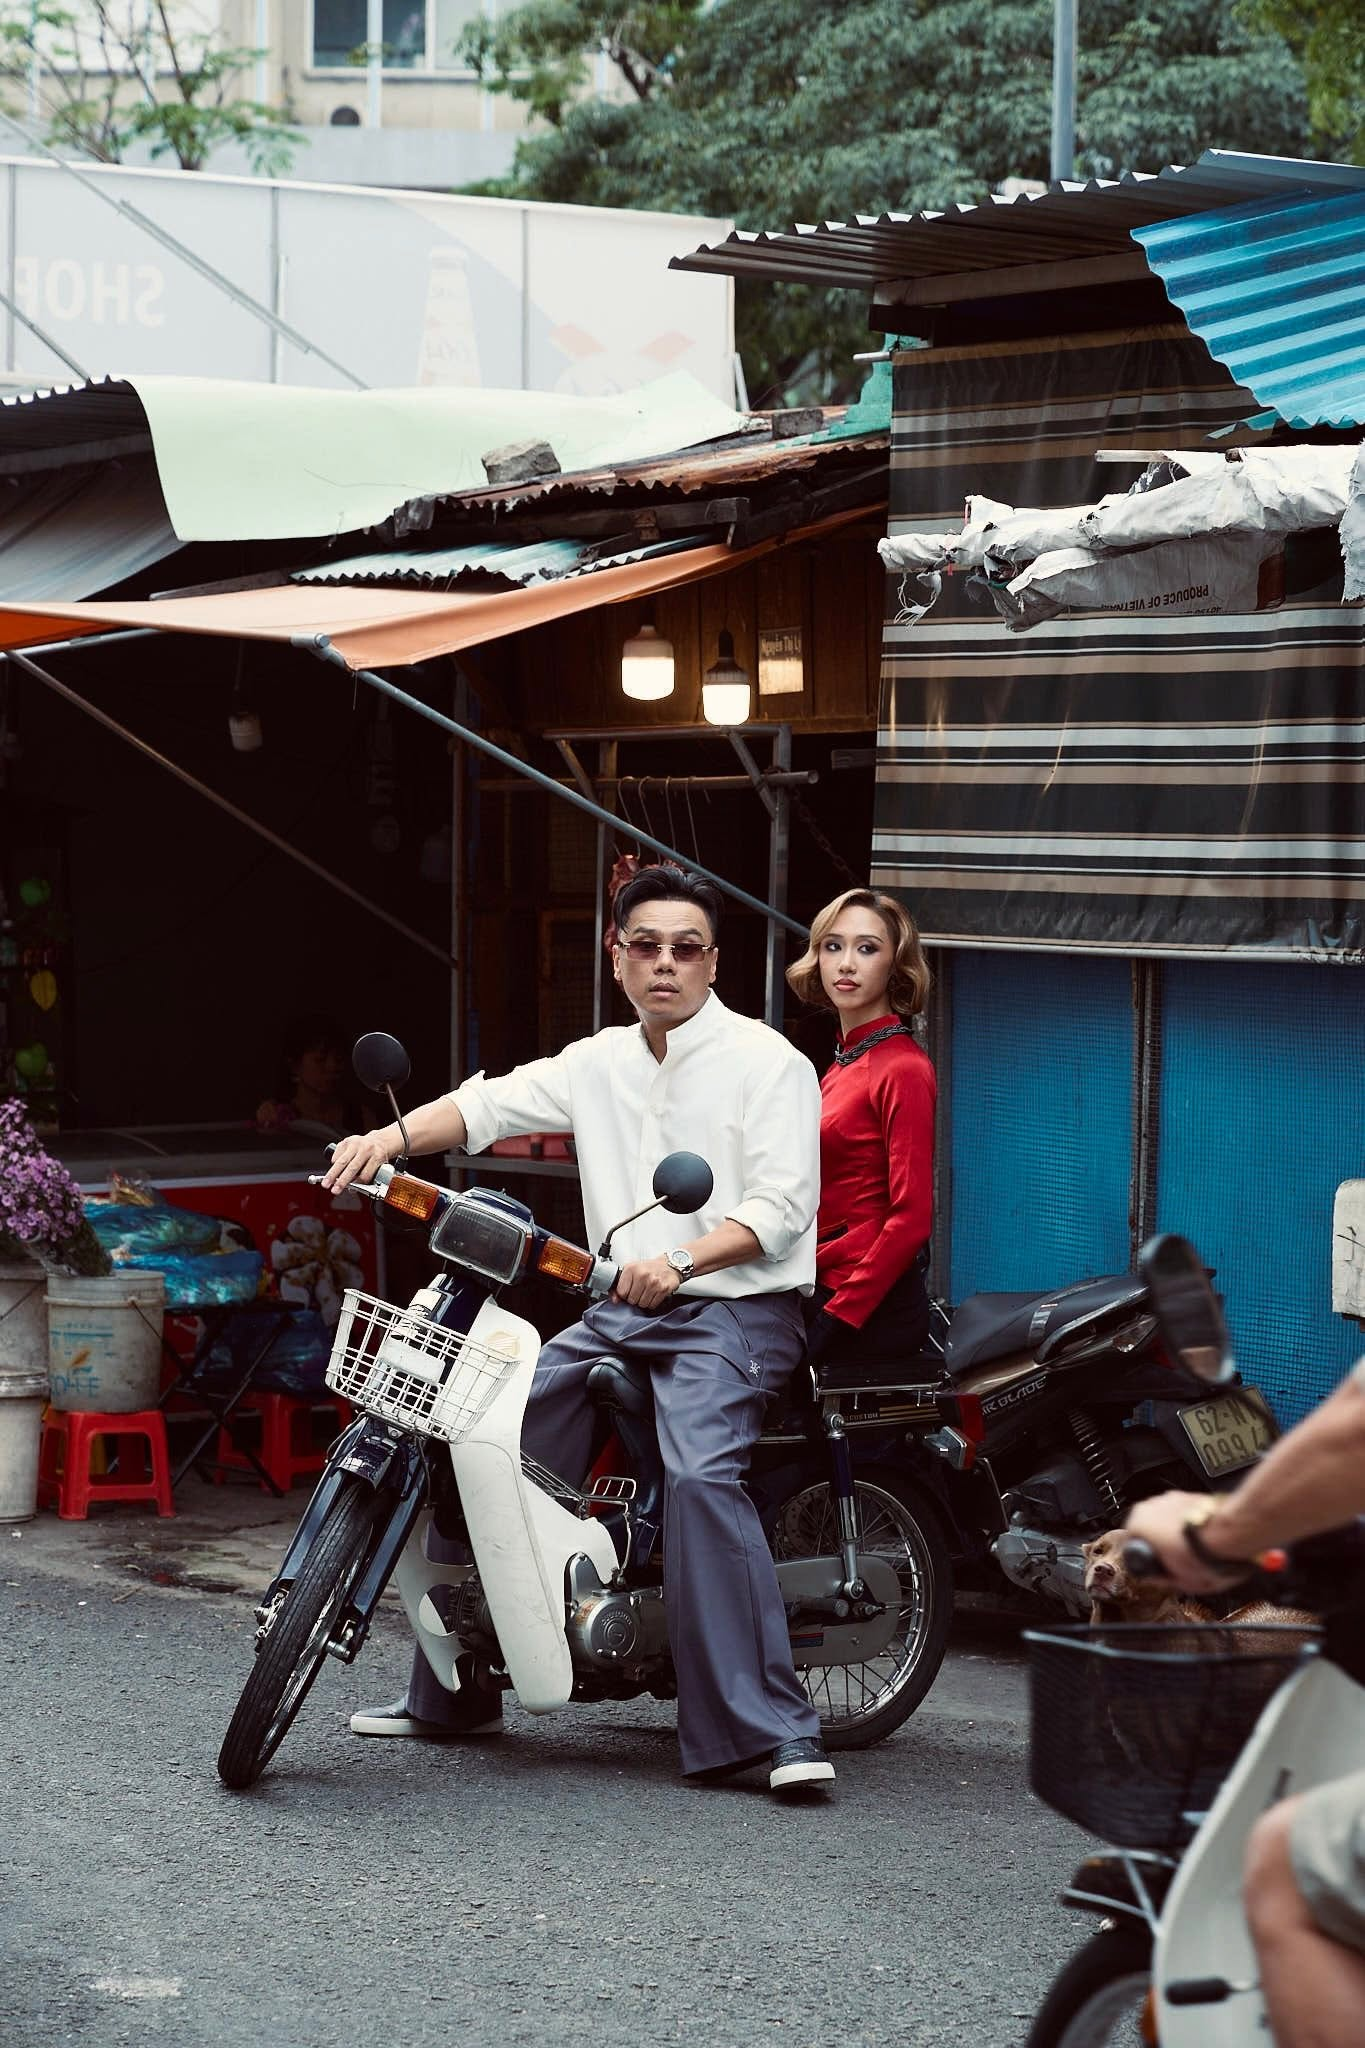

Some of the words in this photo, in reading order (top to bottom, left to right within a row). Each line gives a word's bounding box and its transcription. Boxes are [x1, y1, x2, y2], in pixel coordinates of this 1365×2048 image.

[1147, 597, 1161, 608] OF
[1163, 584, 1209, 607] PRODUCE
[998, 1376, 1047, 1408] BLADE
